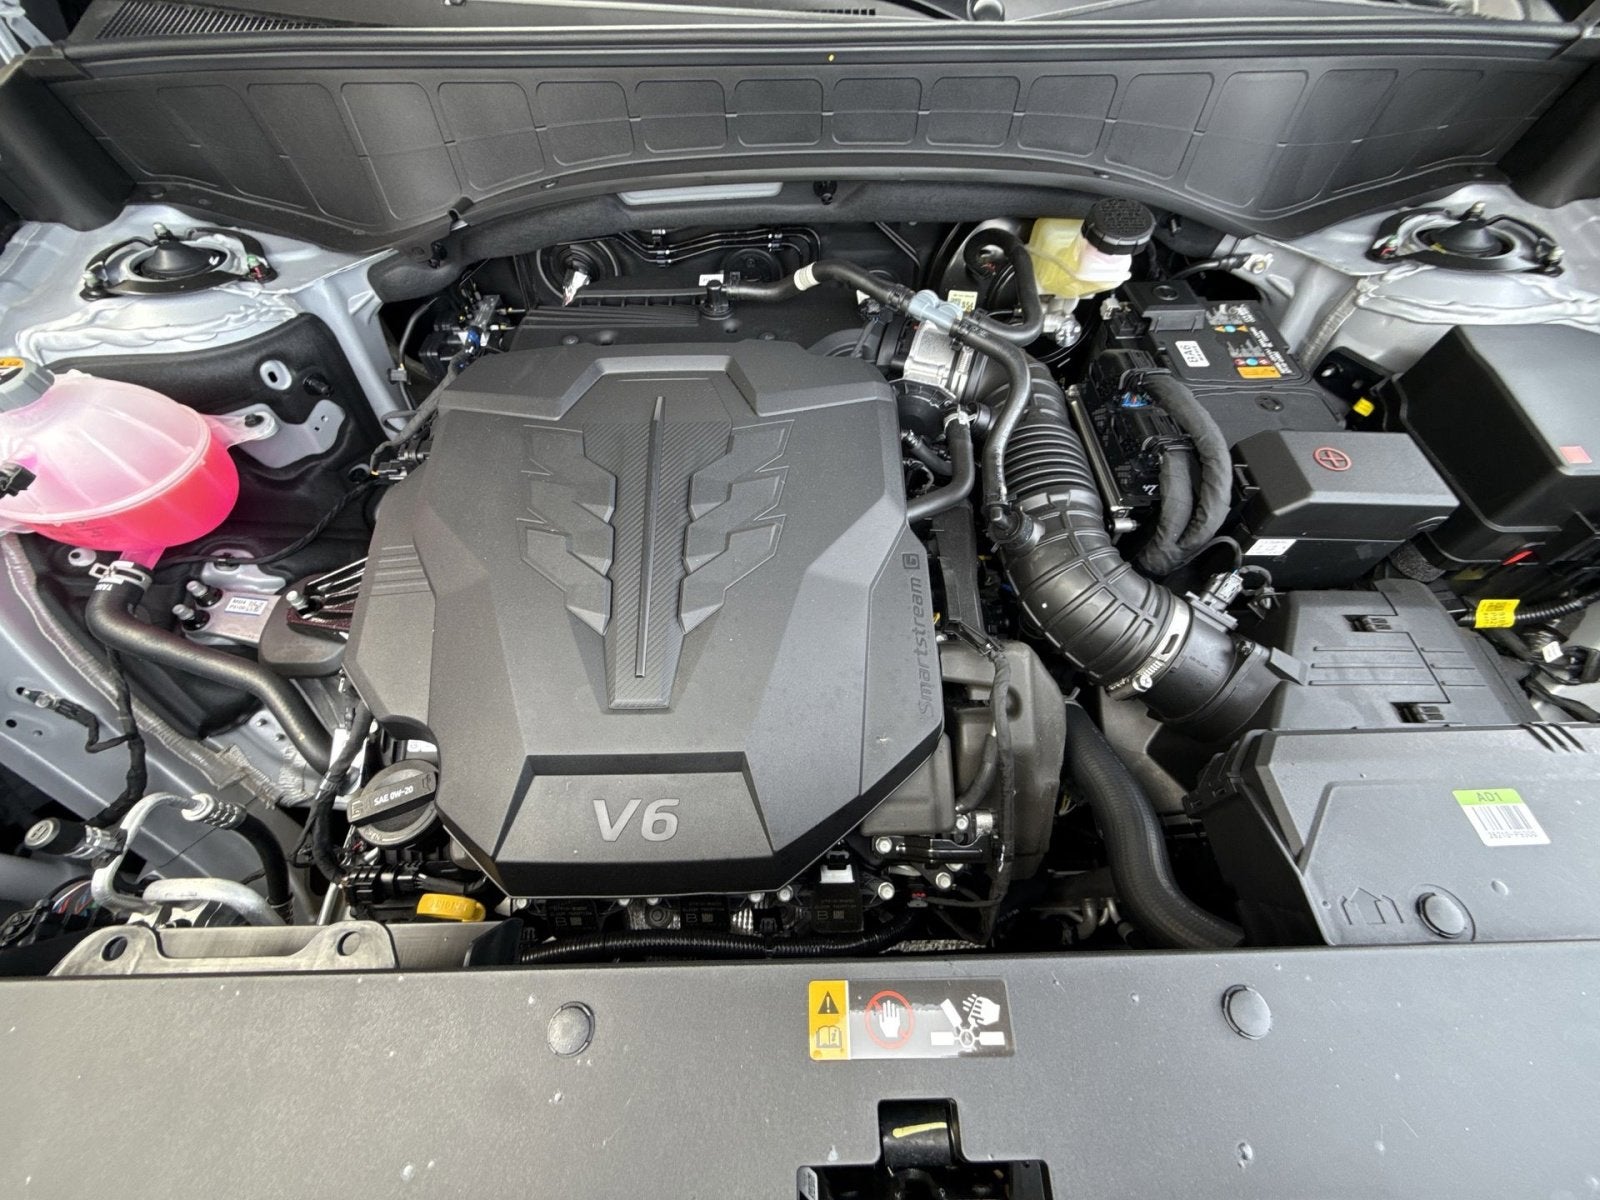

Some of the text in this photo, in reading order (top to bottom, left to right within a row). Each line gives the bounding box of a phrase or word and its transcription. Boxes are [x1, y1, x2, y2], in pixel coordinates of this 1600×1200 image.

[910, 577, 936, 720] Smartstream
[373, 785, 414, 806] SAE 0W-20
[592, 798, 681, 842] V6
